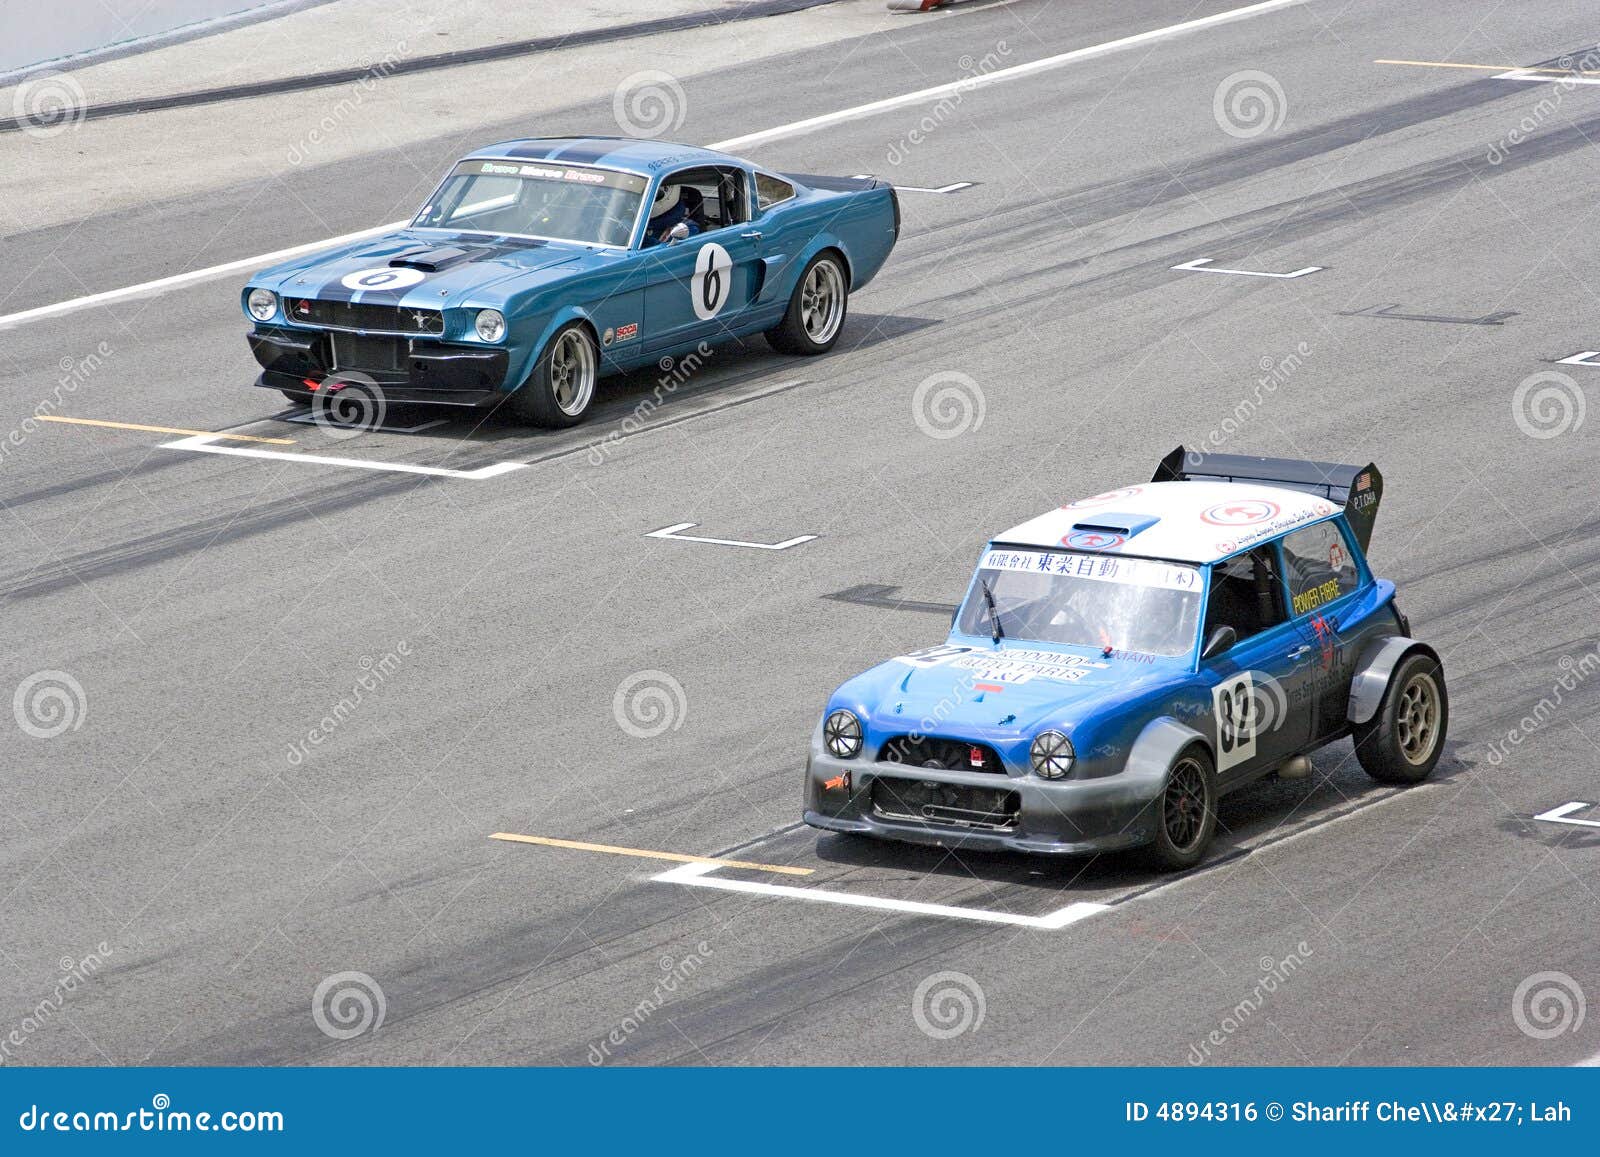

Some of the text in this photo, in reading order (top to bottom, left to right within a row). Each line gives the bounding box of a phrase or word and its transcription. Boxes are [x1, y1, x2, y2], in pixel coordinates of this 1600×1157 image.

[703, 249, 720, 312] 6
[1293, 577, 1341, 615] POWER FIBRE
[1219, 681, 1251, 753] 82
